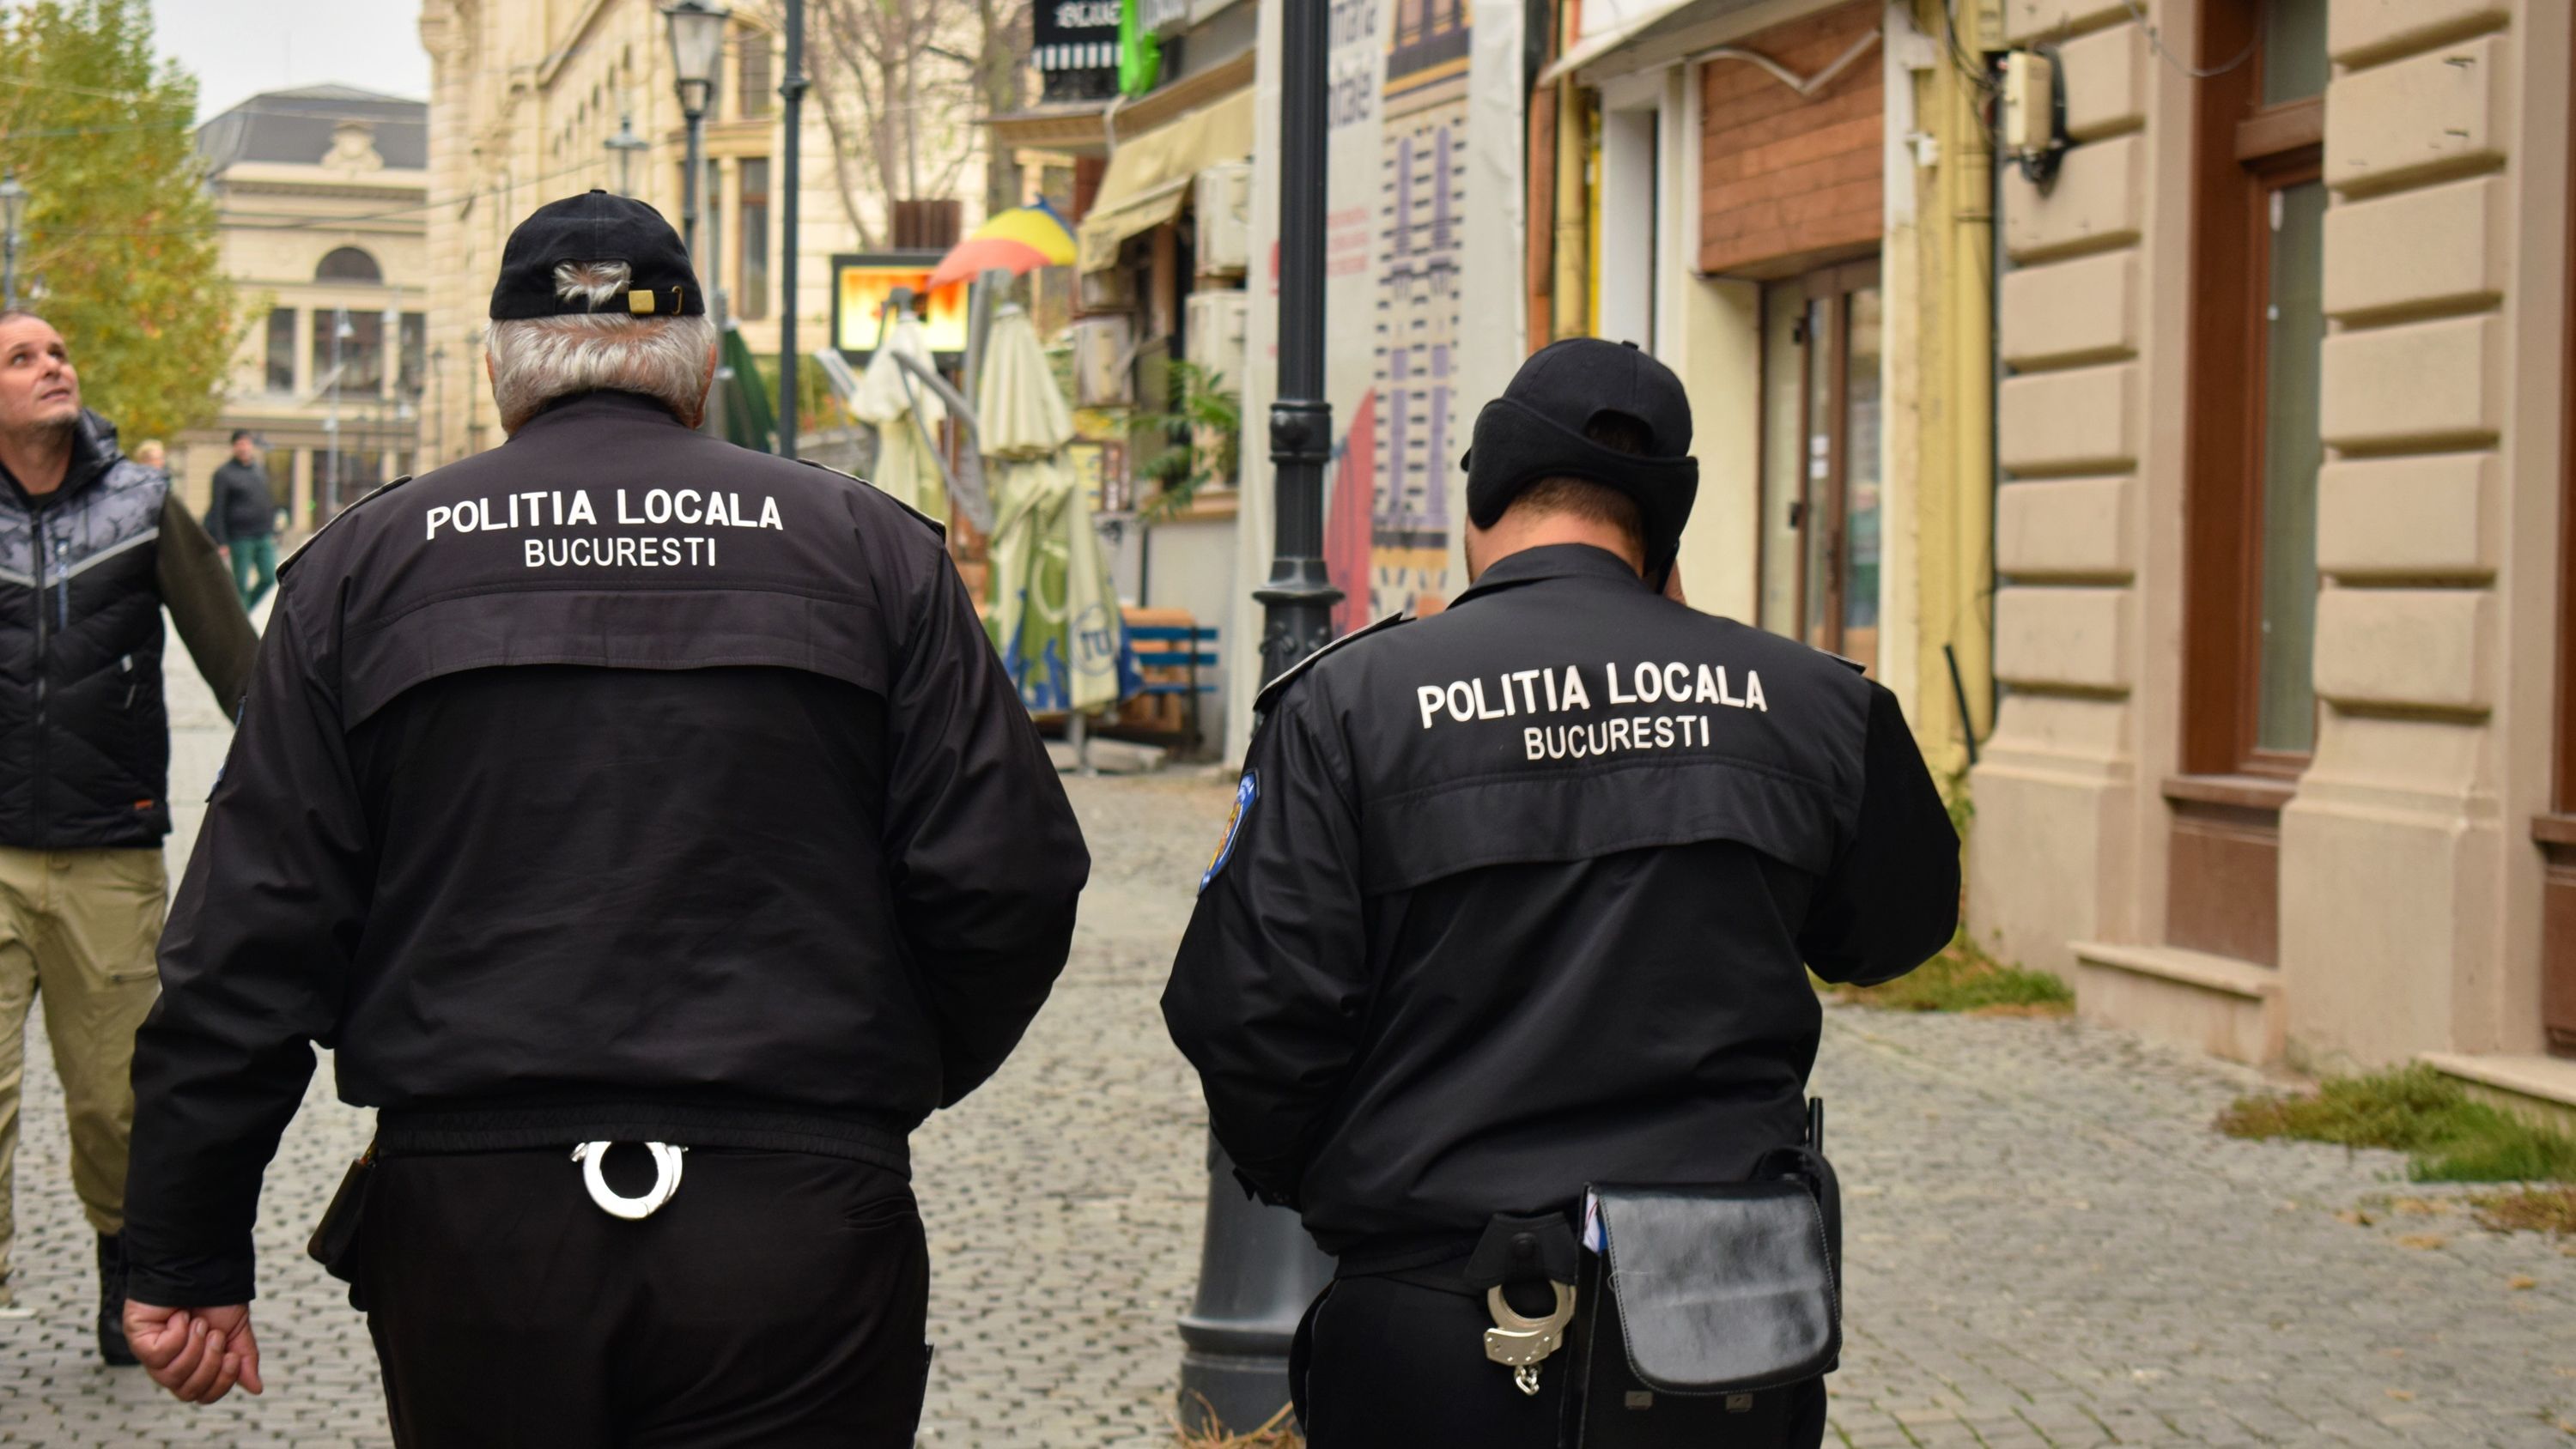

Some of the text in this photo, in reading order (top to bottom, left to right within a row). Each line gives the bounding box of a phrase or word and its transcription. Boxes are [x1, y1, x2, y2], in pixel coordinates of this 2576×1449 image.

[427, 488, 784, 540] POLITIA LOCALA
[524, 537, 716, 567] BUCURESTI
[1417, 661, 1768, 729] POLITIA LOCALA
[1523, 715, 1710, 761] BUCURESTI
